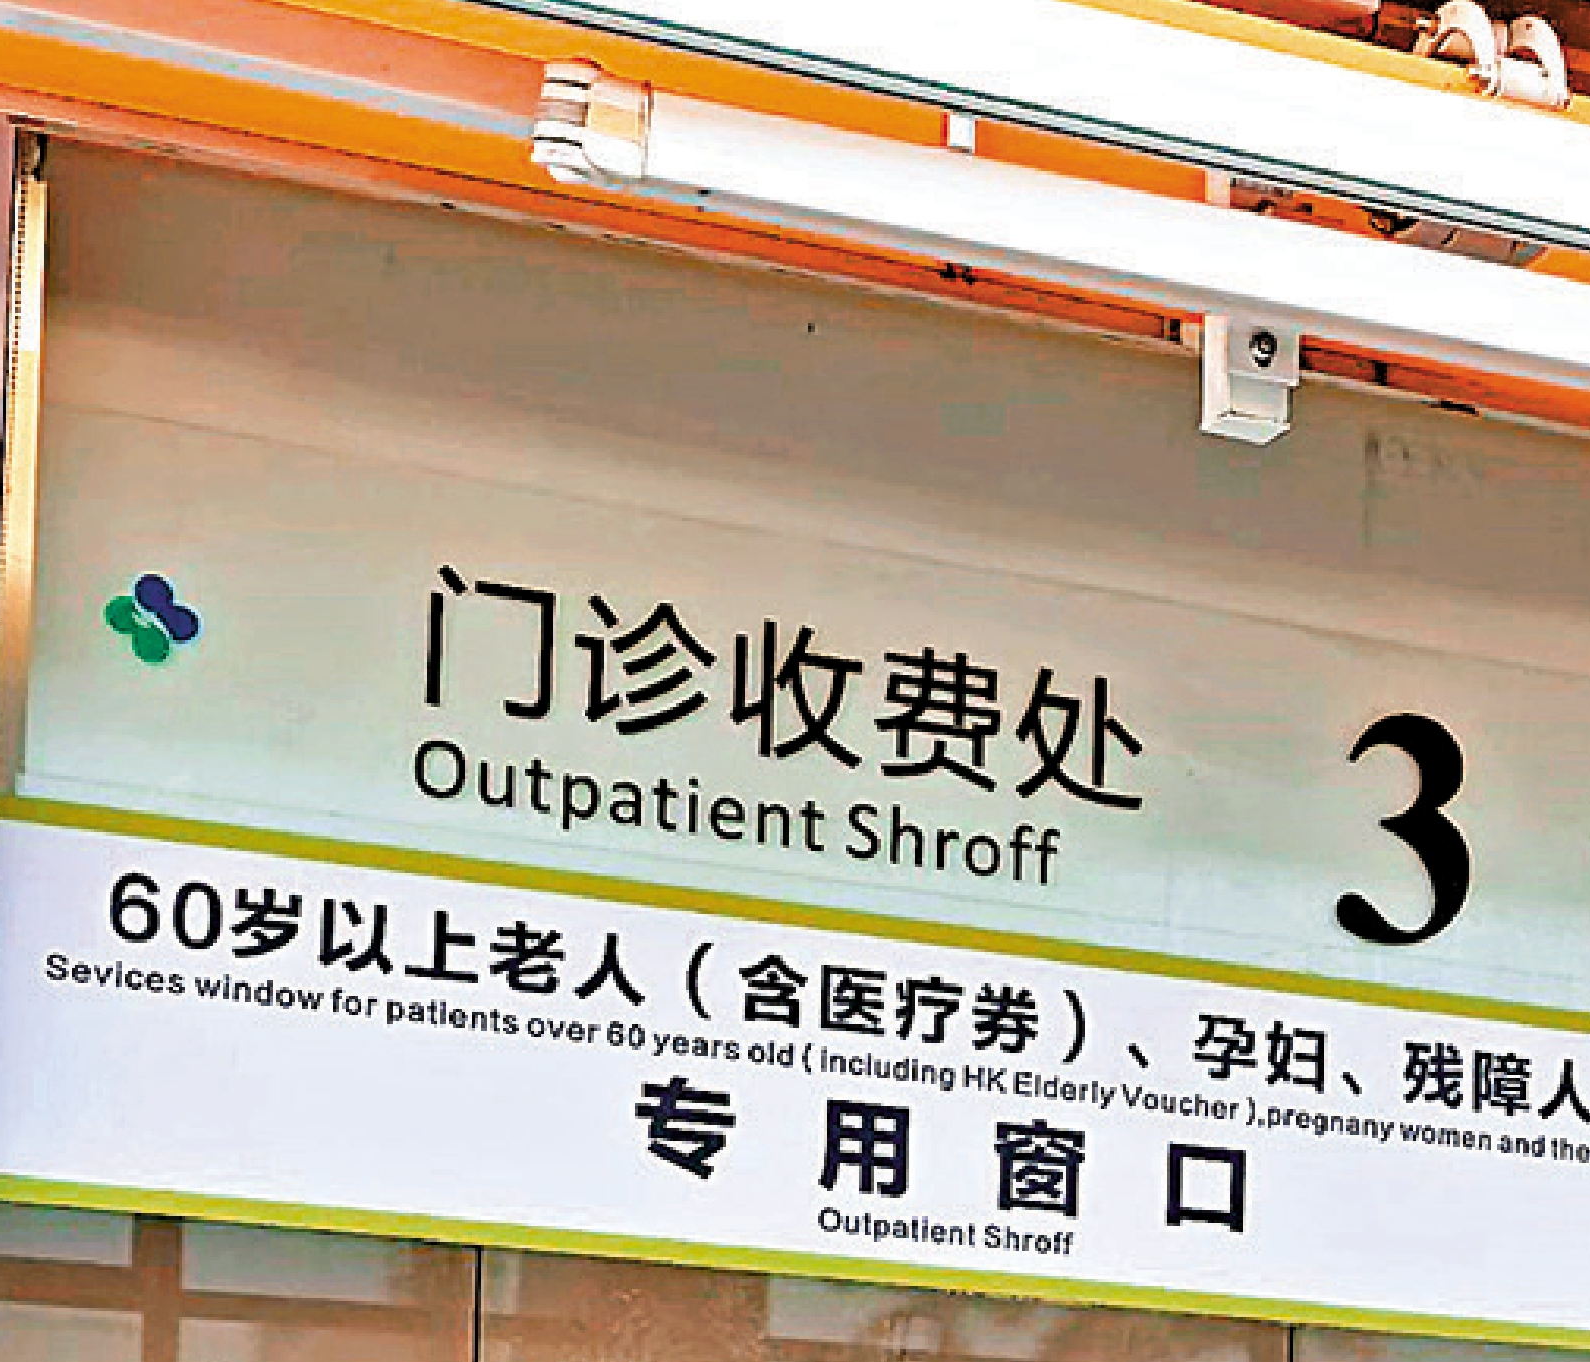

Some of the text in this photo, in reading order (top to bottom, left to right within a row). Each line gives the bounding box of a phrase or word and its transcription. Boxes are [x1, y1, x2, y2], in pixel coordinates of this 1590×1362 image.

[424, 565, 1142, 810] 门诊收费处
[414, 740, 1060, 884] Outpatient Shroff
[1337, 713, 1469, 946] 3
[47, 952, 184, 996] Sevices
[195, 973, 323, 1012] window
[331, 987, 377, 1018] for
[386, 999, 517, 1035] patients
[527, 1017, 598, 1044] over
[607, 1020, 647, 1050] 60
[652, 1033, 739, 1062] years
[748, 1040, 792, 1069] old
[821, 1046, 953, 1092] including
[961, 1064, 1006, 1094] HK
[1014, 1071, 1112, 1110] Elderly
[1120, 1084, 1238, 1120] Voucher
[1400, 1122, 1491, 1150] women
[1498, 1135, 1546, 1158] and
[1548, 1138, 1590, 1163] the
[635, 1075, 1246, 1235] 专用窗口
[818, 1206, 1073, 1255] Outpatient Shroff
